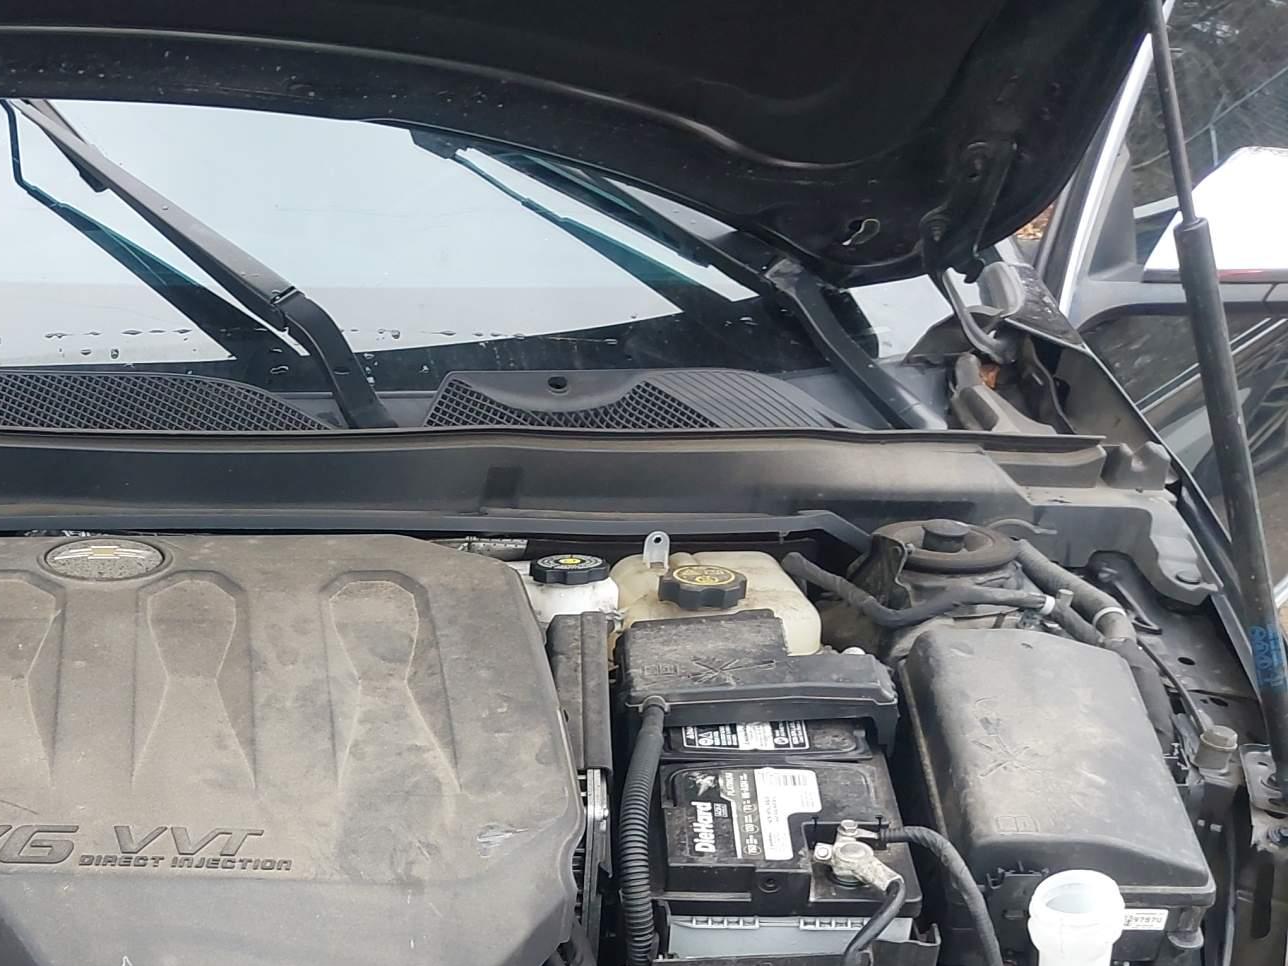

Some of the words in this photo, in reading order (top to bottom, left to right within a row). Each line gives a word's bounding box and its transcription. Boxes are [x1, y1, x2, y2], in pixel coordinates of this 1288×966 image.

[114, 825, 264, 857] VVT
[691, 801, 716, 853] DieHard
[78, 854, 165, 868] DIRECT
[171, 856, 292, 871] INJECTION
